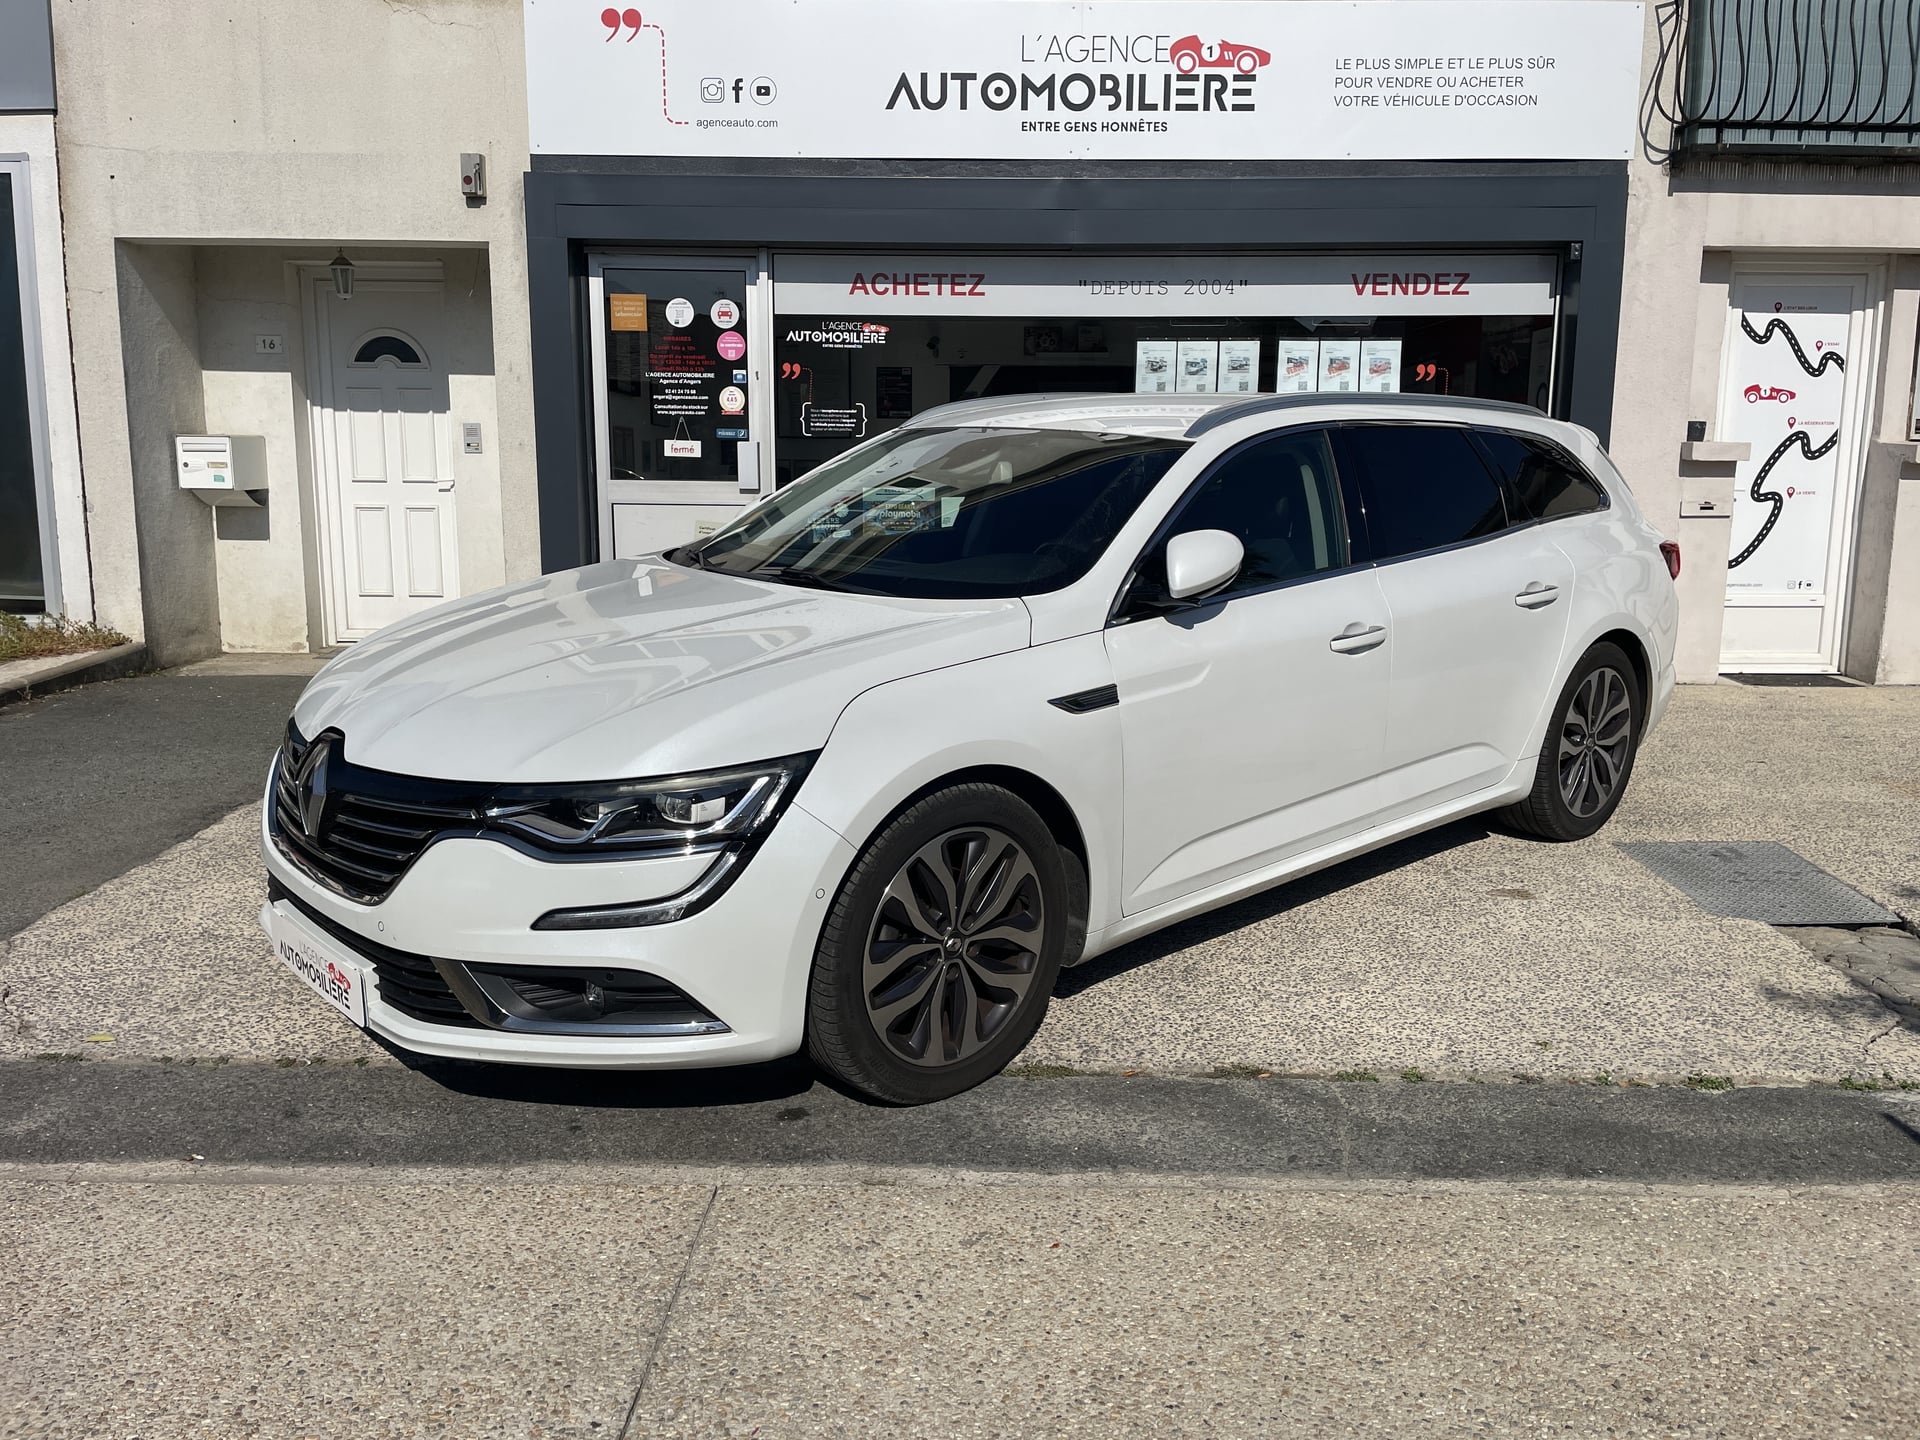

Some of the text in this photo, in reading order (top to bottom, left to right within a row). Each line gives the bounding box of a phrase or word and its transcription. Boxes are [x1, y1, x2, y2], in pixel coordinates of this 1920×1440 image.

[1021, 35, 1170, 62] L'AGENCE
[1335, 56, 1555, 70] LE PLUS SIMPLE ET LE PLUS SÛR
[1335, 76, 1524, 88] POUR VENDRE OU ACHETER
[1334, 93, 1538, 107] VOTRE VÉHICULE D'OCCASION
[696, 118, 778, 129] agenceauto.com
[1021, 119, 1168, 132] ENTRE GENS HONNÊTES
[849, 272, 986, 296] ACHETEZ
[1078, 279, 1248, 295] "DEPUIS 2004"
[1351, 273, 1470, 296] VENDEZ
[822, 322, 863, 330] L'AGENCE
[262, 339, 276, 350] 16
[671, 444, 695, 454] fermé
